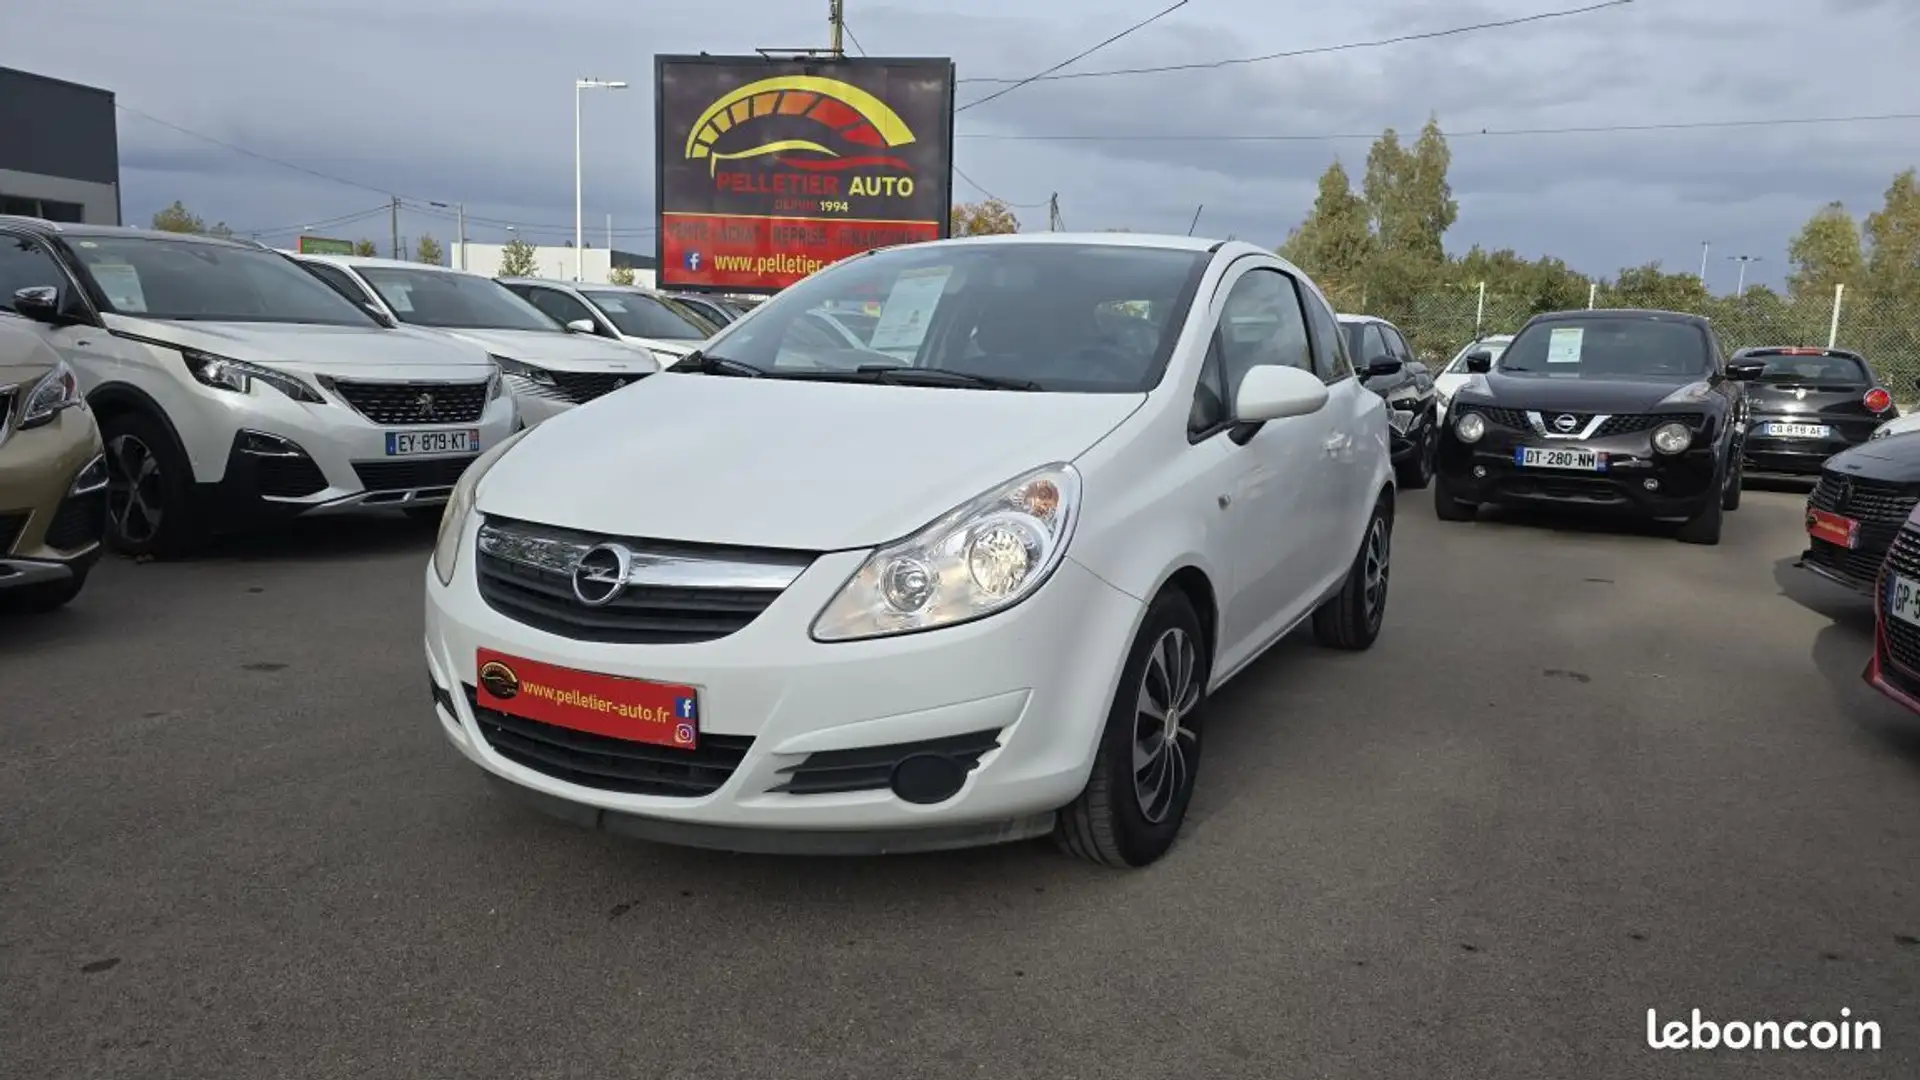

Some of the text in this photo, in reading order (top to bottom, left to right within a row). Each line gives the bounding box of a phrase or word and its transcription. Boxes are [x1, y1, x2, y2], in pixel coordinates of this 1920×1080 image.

[716, 173, 914, 197] PELLETIER AUTO
[820, 200, 848, 212] 1994
[773, 226, 827, 245] REPRISE
[398, 433, 466, 452] EY-879-KT
[522, 679, 670, 723] www.pelletier-auto.fr
